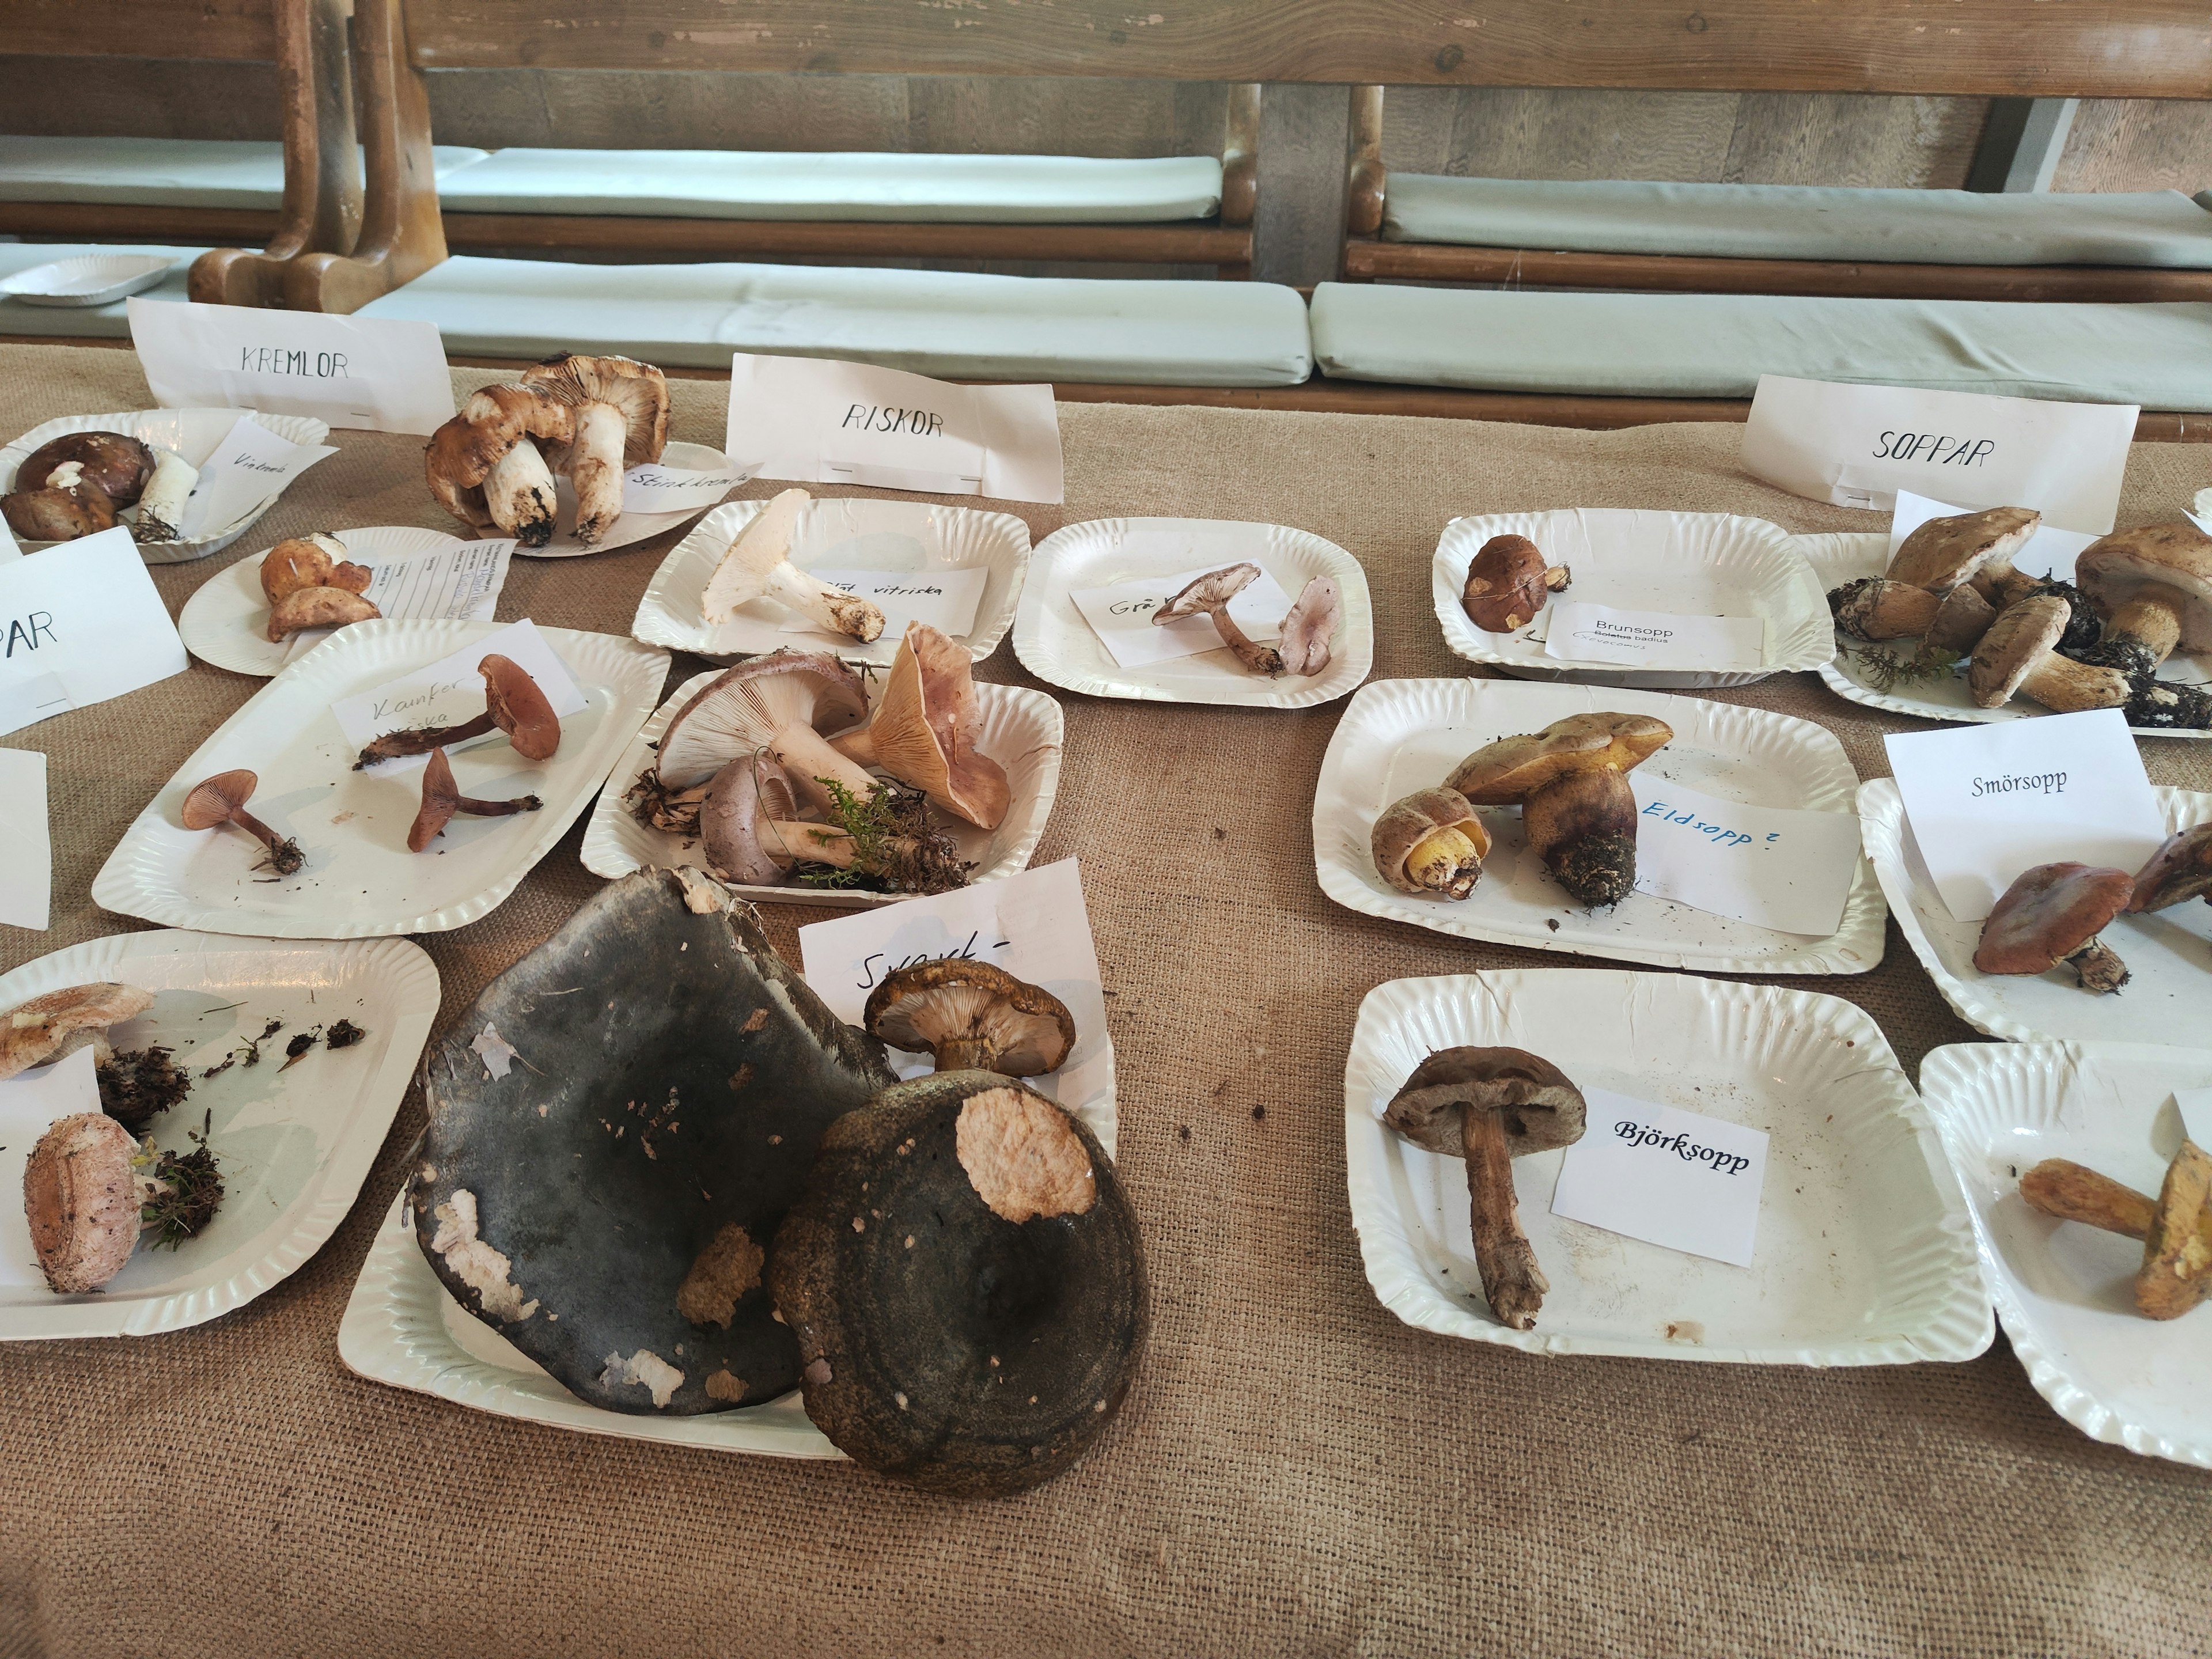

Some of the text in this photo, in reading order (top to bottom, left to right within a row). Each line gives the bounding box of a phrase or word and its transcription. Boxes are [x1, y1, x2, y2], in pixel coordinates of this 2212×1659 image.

[241, 347, 349, 378] KREMLOR
[842, 404, 944, 437] RISKOR
[1872, 430, 1995, 467] SOPPAR
[874, 585, 942, 596] vitriska
[1109, 599, 1156, 615] Grå
[0, 611, 58, 658] AR
[1596, 620, 1673, 638] Brunsopp
[1635, 635, 1669, 643] badius
[1971, 772, 2067, 797] Smörsopp
[1642, 802, 1752, 847] Eldsopp
[1614, 1121, 1749, 1176] Björksopp
